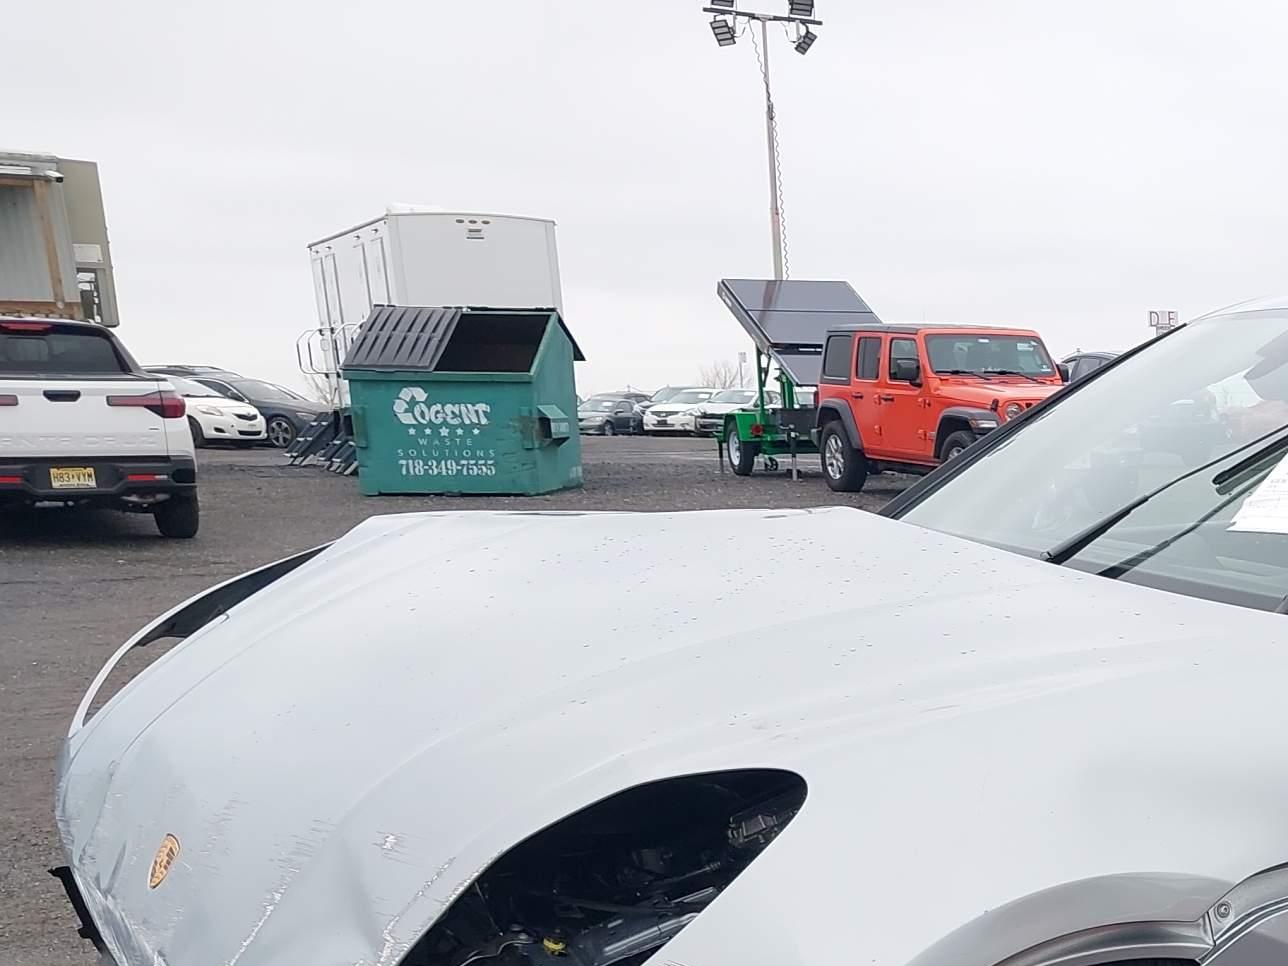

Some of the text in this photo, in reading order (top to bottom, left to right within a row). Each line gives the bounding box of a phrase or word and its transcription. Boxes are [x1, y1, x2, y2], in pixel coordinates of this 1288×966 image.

[393, 387, 491, 425] COGENT
[418, 438, 473, 446] WASTE
[397, 449, 496, 457] SOLUTIONS
[398, 460, 497, 476] 718-349-7555
